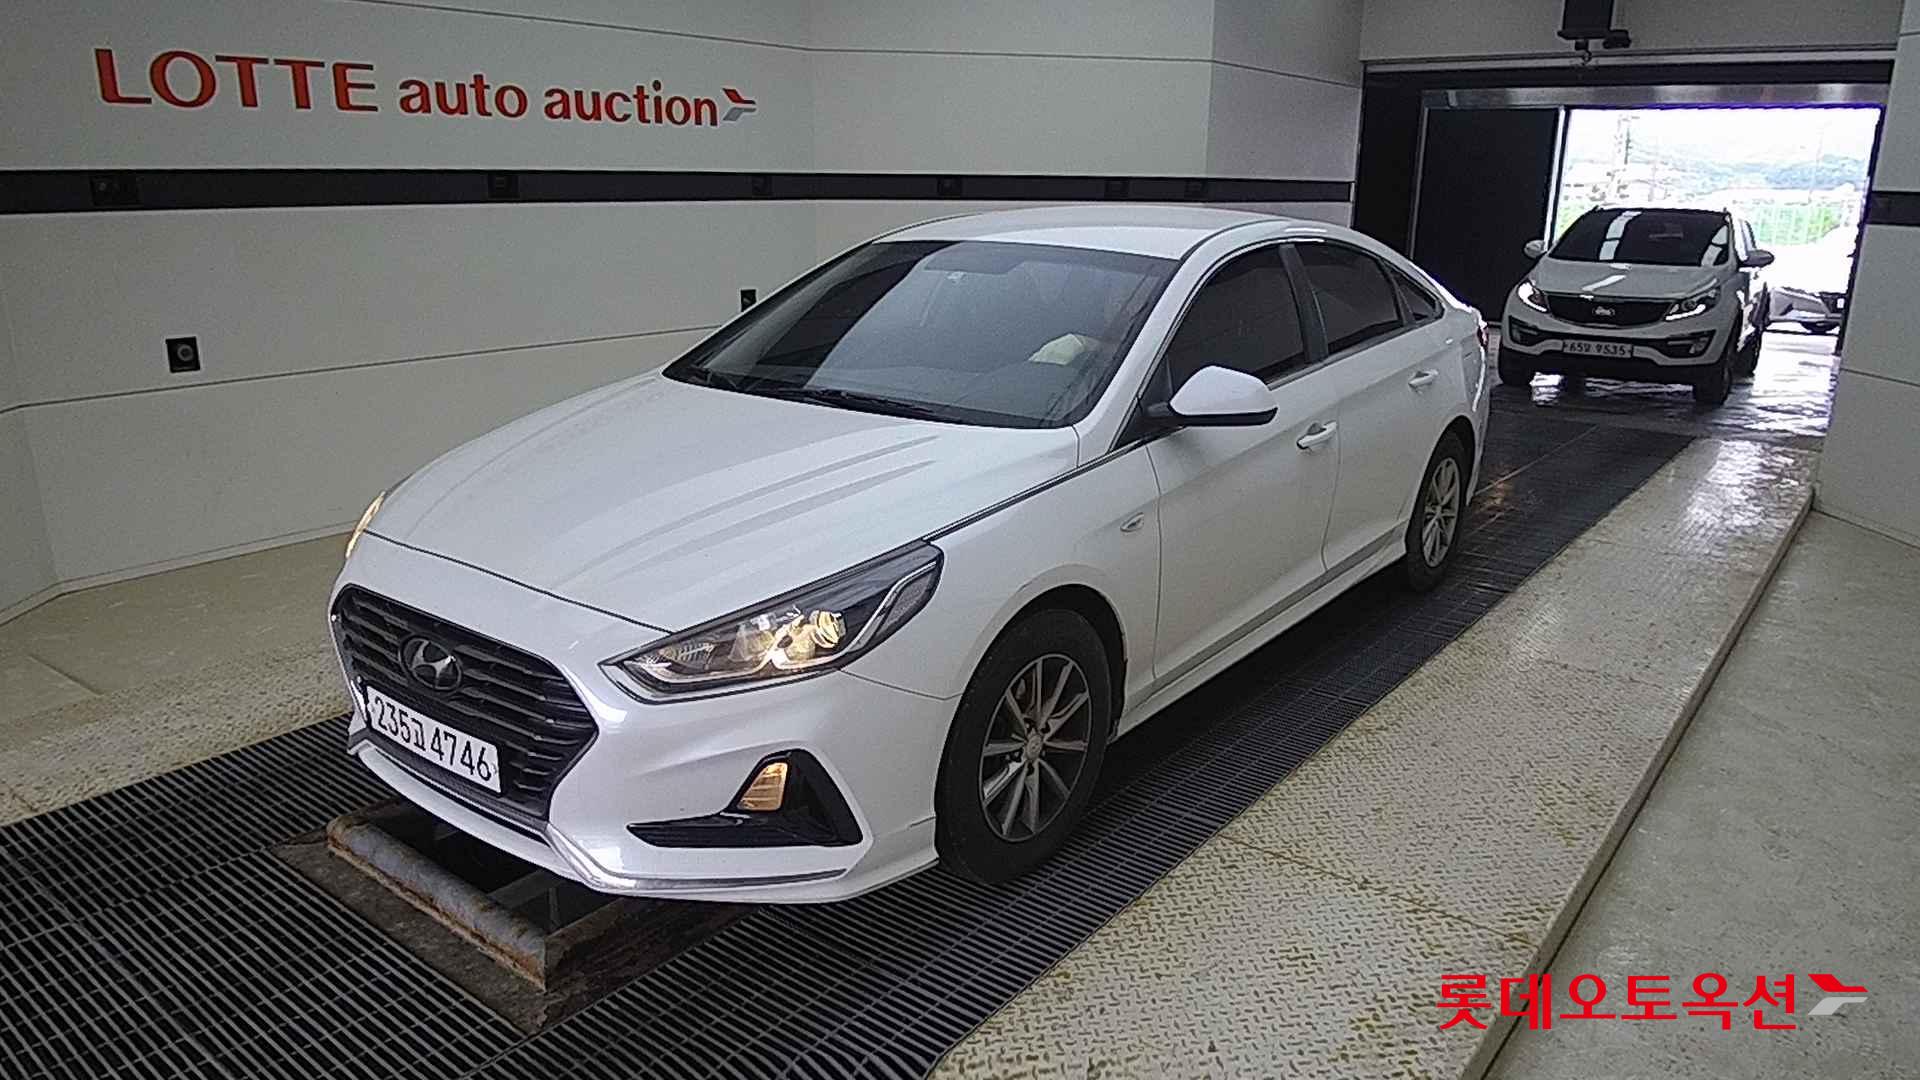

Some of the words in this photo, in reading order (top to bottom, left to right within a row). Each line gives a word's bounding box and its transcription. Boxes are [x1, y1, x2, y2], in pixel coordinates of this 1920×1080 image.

[94, 47, 380, 112] LOTTE
[398, 74, 528, 118] auto
[543, 79, 719, 128] auction
[374, 695, 427, 752] 235고
[430, 726, 492, 782] 4746
